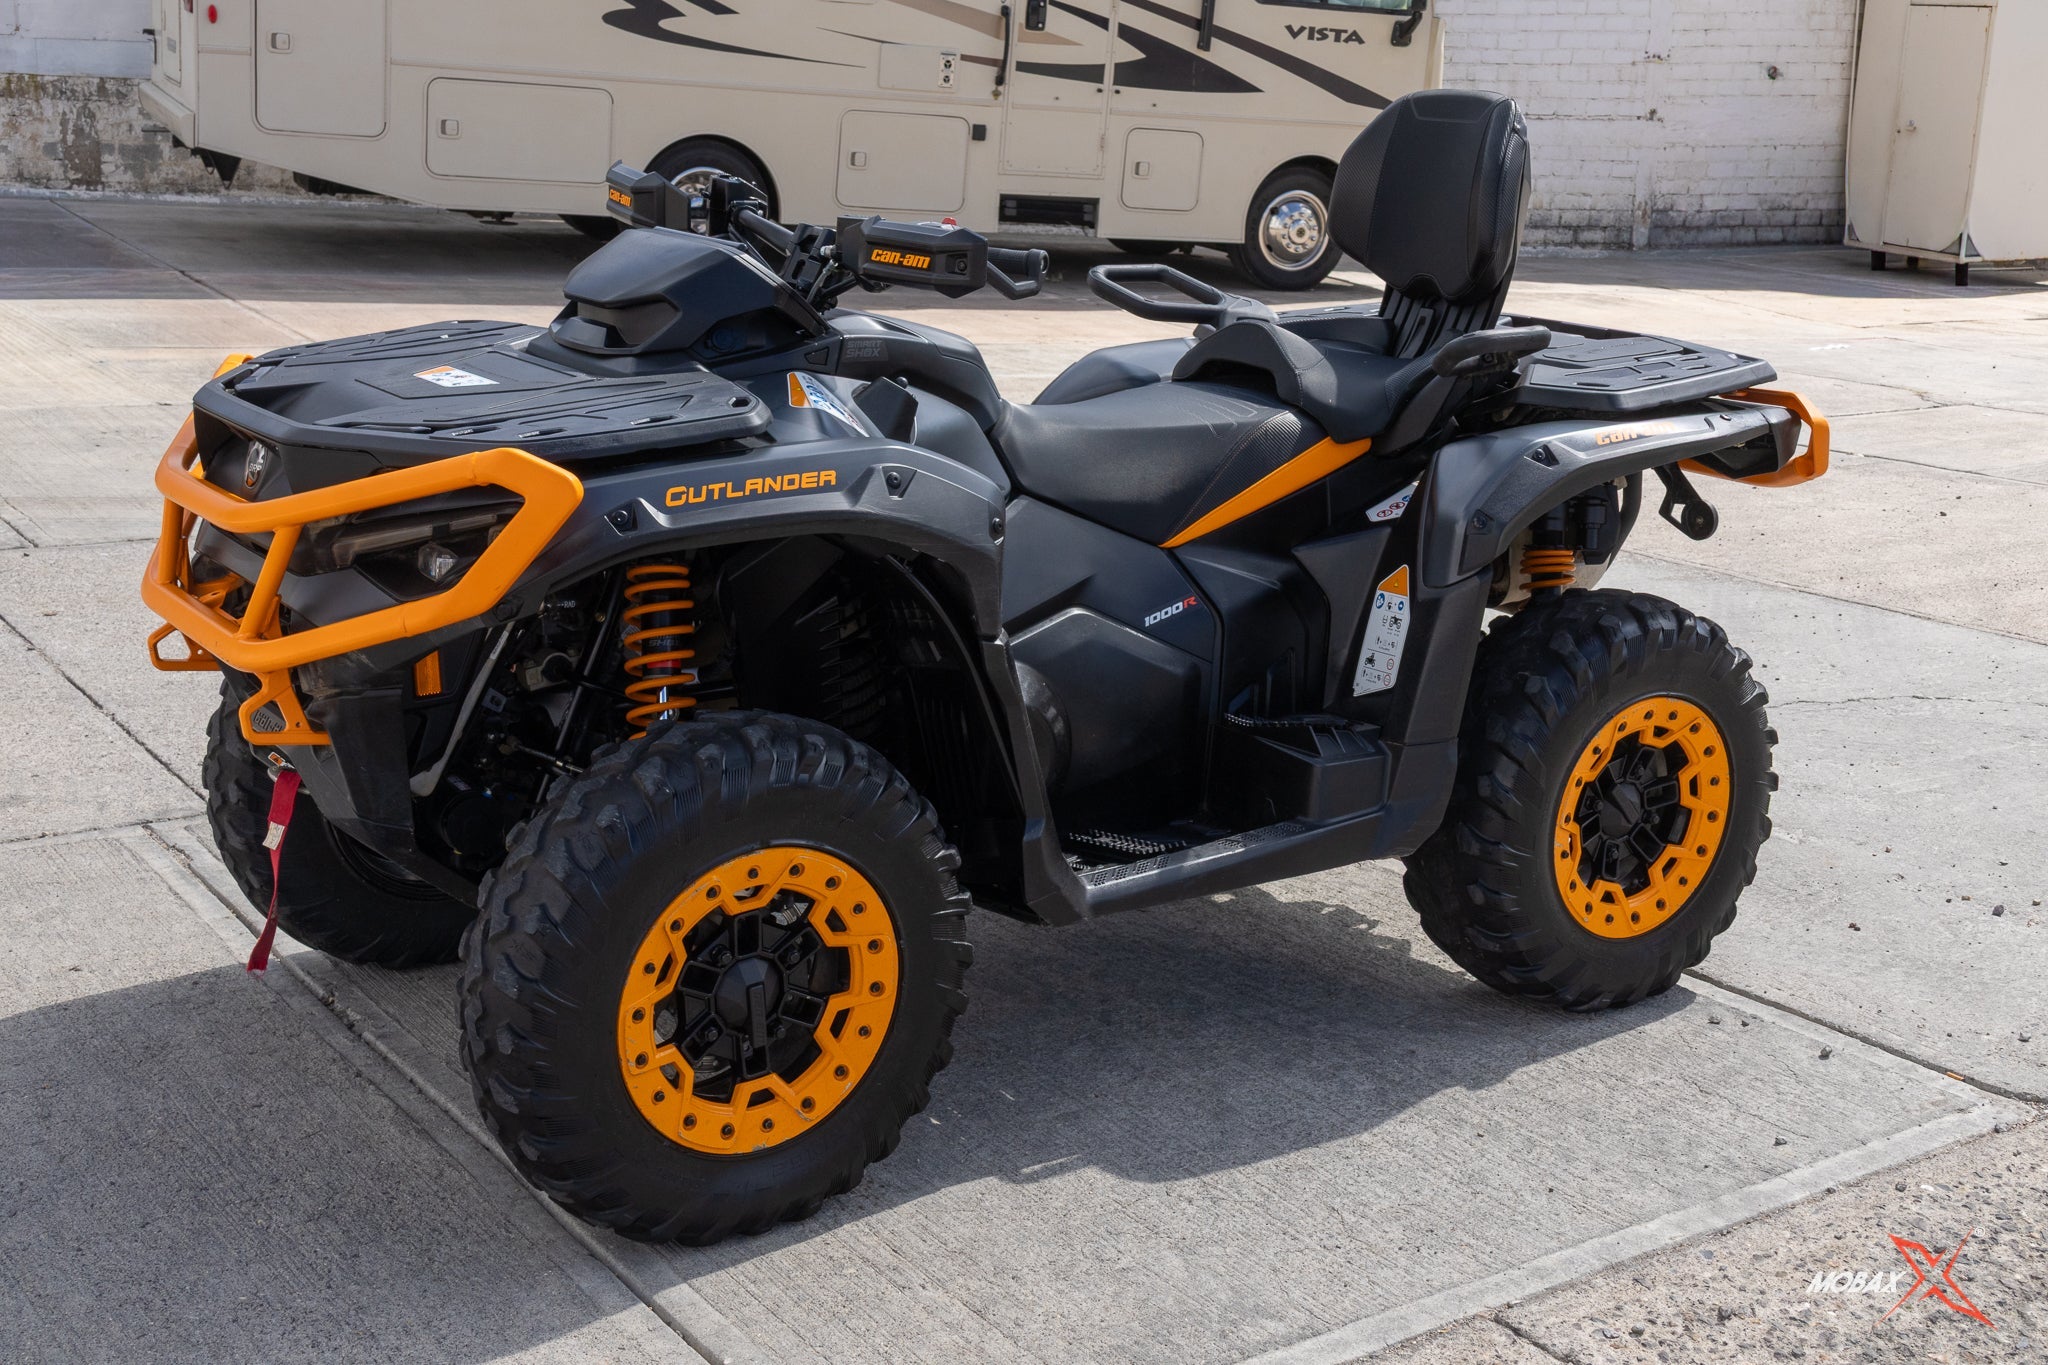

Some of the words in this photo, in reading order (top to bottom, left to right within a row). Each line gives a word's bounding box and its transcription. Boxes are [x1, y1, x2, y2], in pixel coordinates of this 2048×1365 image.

[1284, 24, 1366, 45] VISTA
[609, 188, 632, 208] can-am
[870, 248, 931, 270] can-am
[846, 340, 883, 348] SMART
[665, 469, 837, 508] OUTLANDER
[1144, 595, 1198, 628] 1000R
